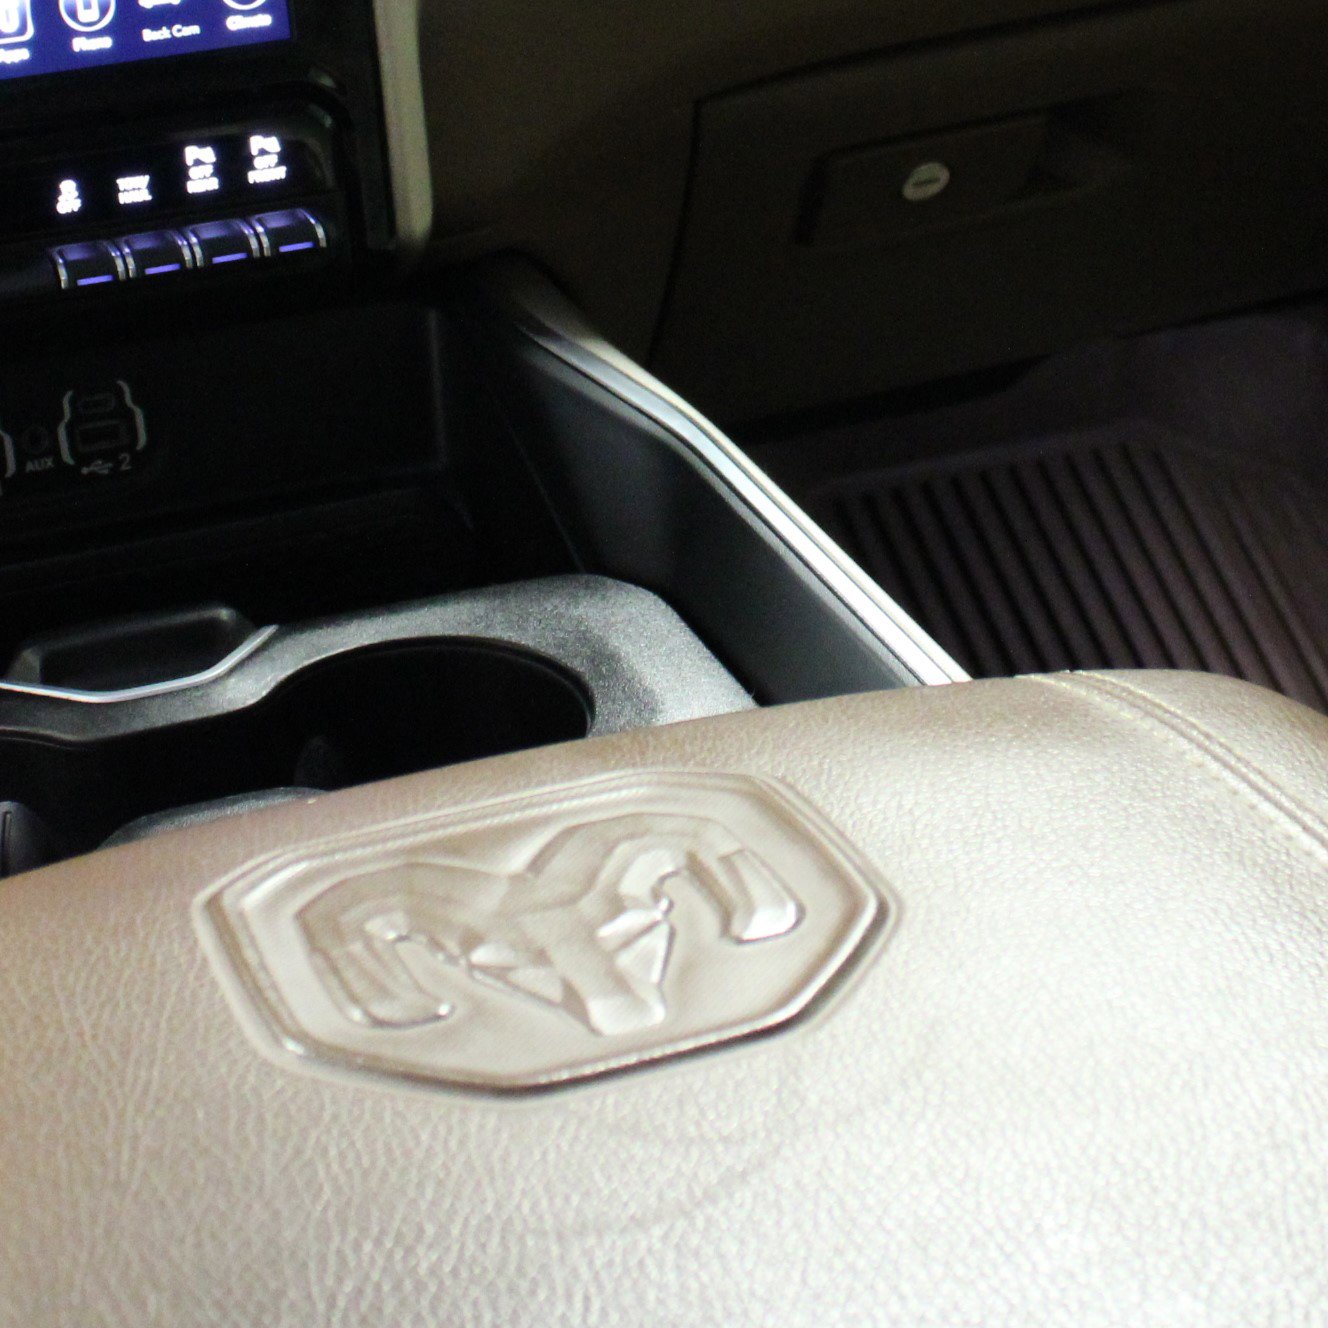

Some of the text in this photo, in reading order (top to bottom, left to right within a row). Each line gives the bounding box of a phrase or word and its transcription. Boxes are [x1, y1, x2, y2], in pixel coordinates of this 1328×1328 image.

[141, 23, 201, 43] Back Cam
[25, 455, 55, 472] AUX
